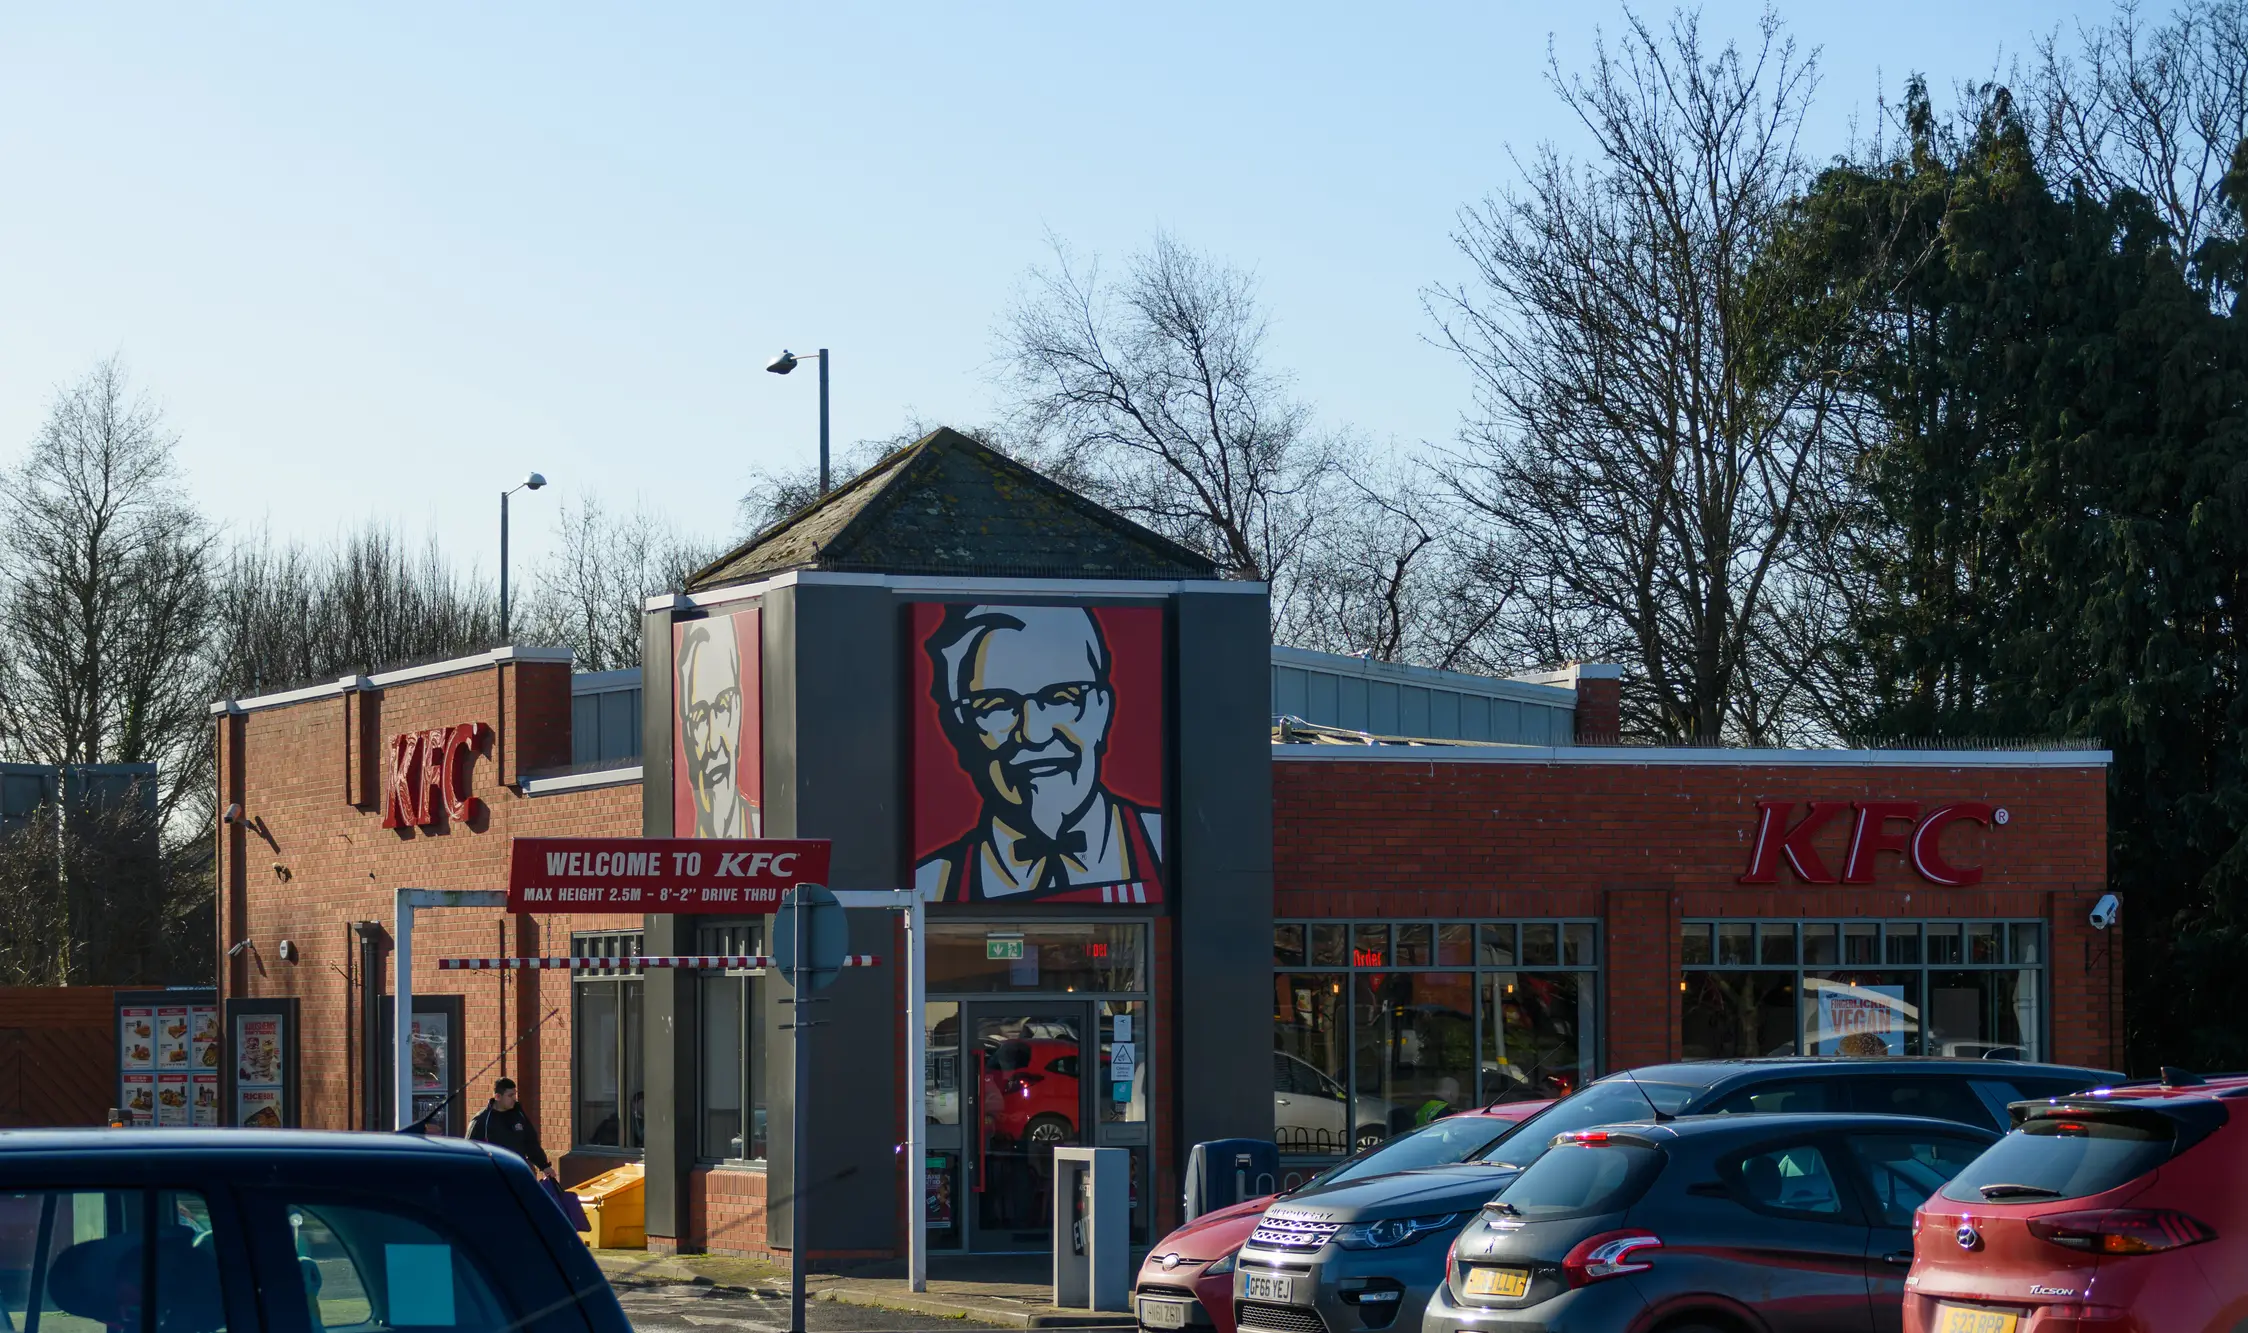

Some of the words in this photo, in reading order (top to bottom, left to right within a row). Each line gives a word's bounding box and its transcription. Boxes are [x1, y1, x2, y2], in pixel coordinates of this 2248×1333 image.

[383, 722, 484, 829] KFC
[1738, 801, 1992, 886] KFC
[546, 852, 661, 876] WELCOME
[672, 852, 701, 876] TO
[714, 852, 798, 877] KFC
[523, 888, 553, 901] MAX
[558, 888, 604, 901] HEIGHT
[609, 888, 641, 901] 2.5M
[701, 888, 738, 901] DRIVE
[744, 888, 776, 901] THRU
[1832, 1010, 1891, 1034] VEGAN
[1250, 1277, 1271, 1296] GF66
[1273, 1279, 1290, 1299] YEJ
[2030, 1284, 2074, 1296] TUCSON
